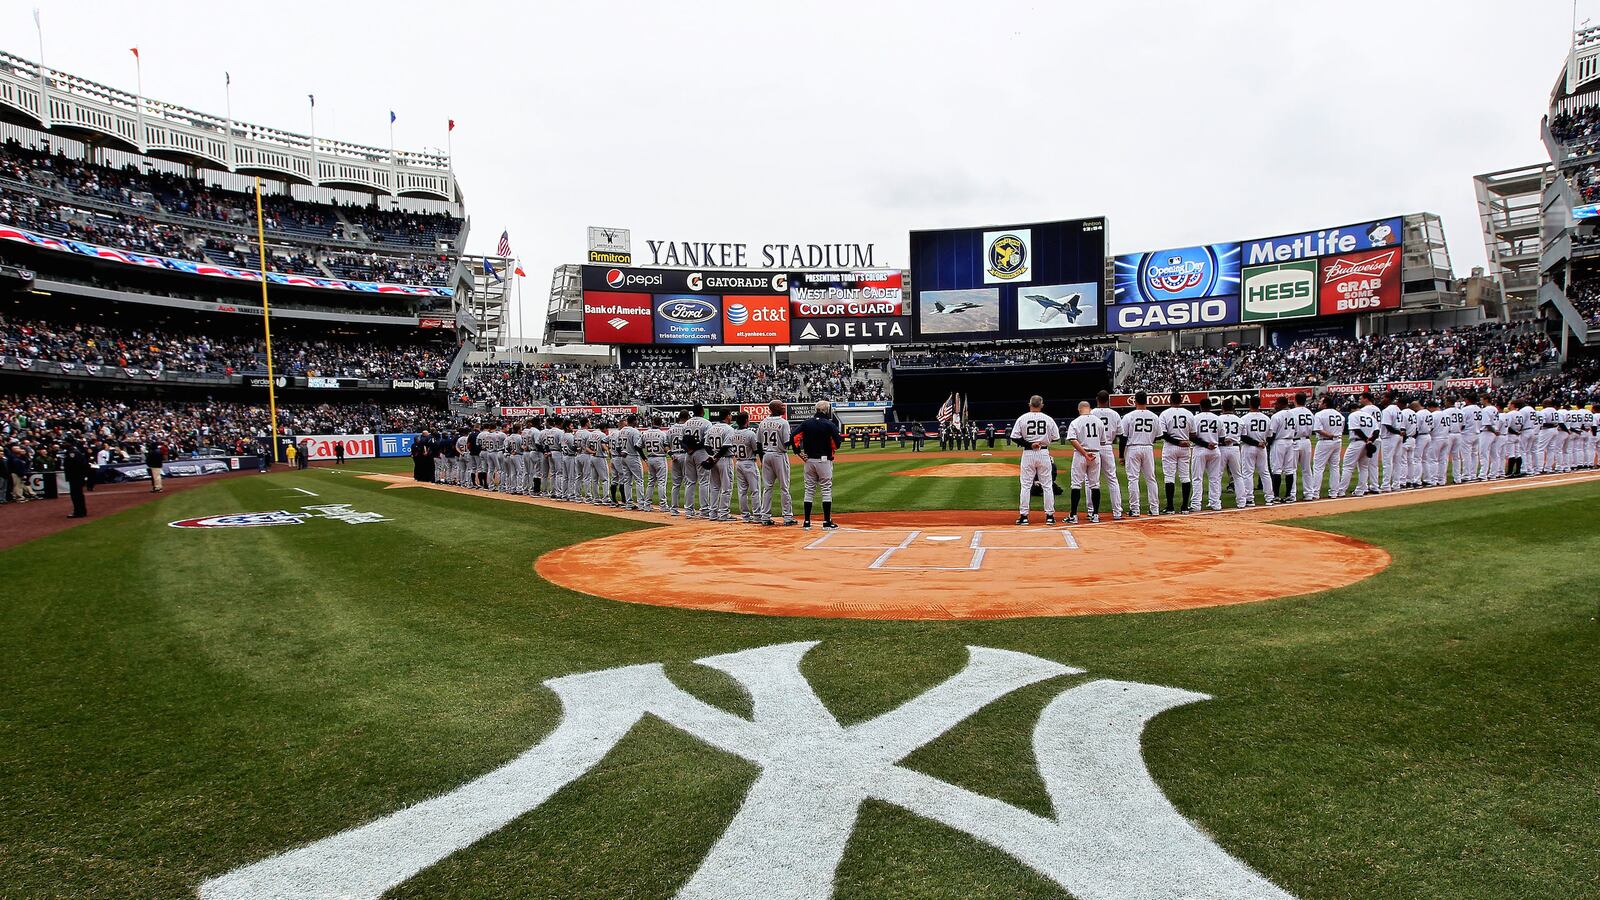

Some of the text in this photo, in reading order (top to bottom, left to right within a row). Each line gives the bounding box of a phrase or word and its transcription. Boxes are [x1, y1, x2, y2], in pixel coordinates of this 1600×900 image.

[646, 240, 875, 268] YANKEE STADIUM
[1249, 230, 1357, 265] MetLife
[590, 251, 630, 263] Armitron
[1148, 261, 1205, 279] Opening Day
[1327, 259, 1393, 277] Budweiser
[626, 274, 663, 287] pepsi
[706, 277, 768, 288] GATORADE
[805, 272, 888, 283] PRESENTING TODAY'S COLORS
[1248, 280, 1310, 302] HESS
[1336, 278, 1382, 293] GRAB
[795, 287, 899, 300] WEST POINT CADET
[1344, 290, 1374, 298] SOME
[584, 304, 651, 316] Bank of America
[799, 303, 895, 315] COLOR GUARD
[1337, 297, 1381, 311] BUDS
[671, 303, 704, 319] Ford
[752, 306, 786, 322] at&t
[1118, 299, 1227, 328] CASIO
[826, 322, 904, 337] DELTA
[392, 379, 436, 390] Poland Spring
[1146, 394, 1191, 405] TOYA
[743, 406, 772, 415] SPOR
[1551, 412, 1559, 421] 18
[1172, 415, 1187, 429] 13
[1284, 417, 1295, 430] 14
[1298, 414, 1313, 426] 65
[1329, 415, 1342, 426] 62
[1360, 416, 1373, 427] 53
[1440, 417, 1451, 426] 40
[1451, 413, 1463, 423] 38
[1027, 420, 1047, 435] 28
[1085, 422, 1098, 437] 11
[1135, 418, 1153, 432] 25
[1200, 419, 1218, 433] 24
[1250, 419, 1267, 432] 20
[763, 431, 777, 446] 14
[646, 441, 660, 452] 25
